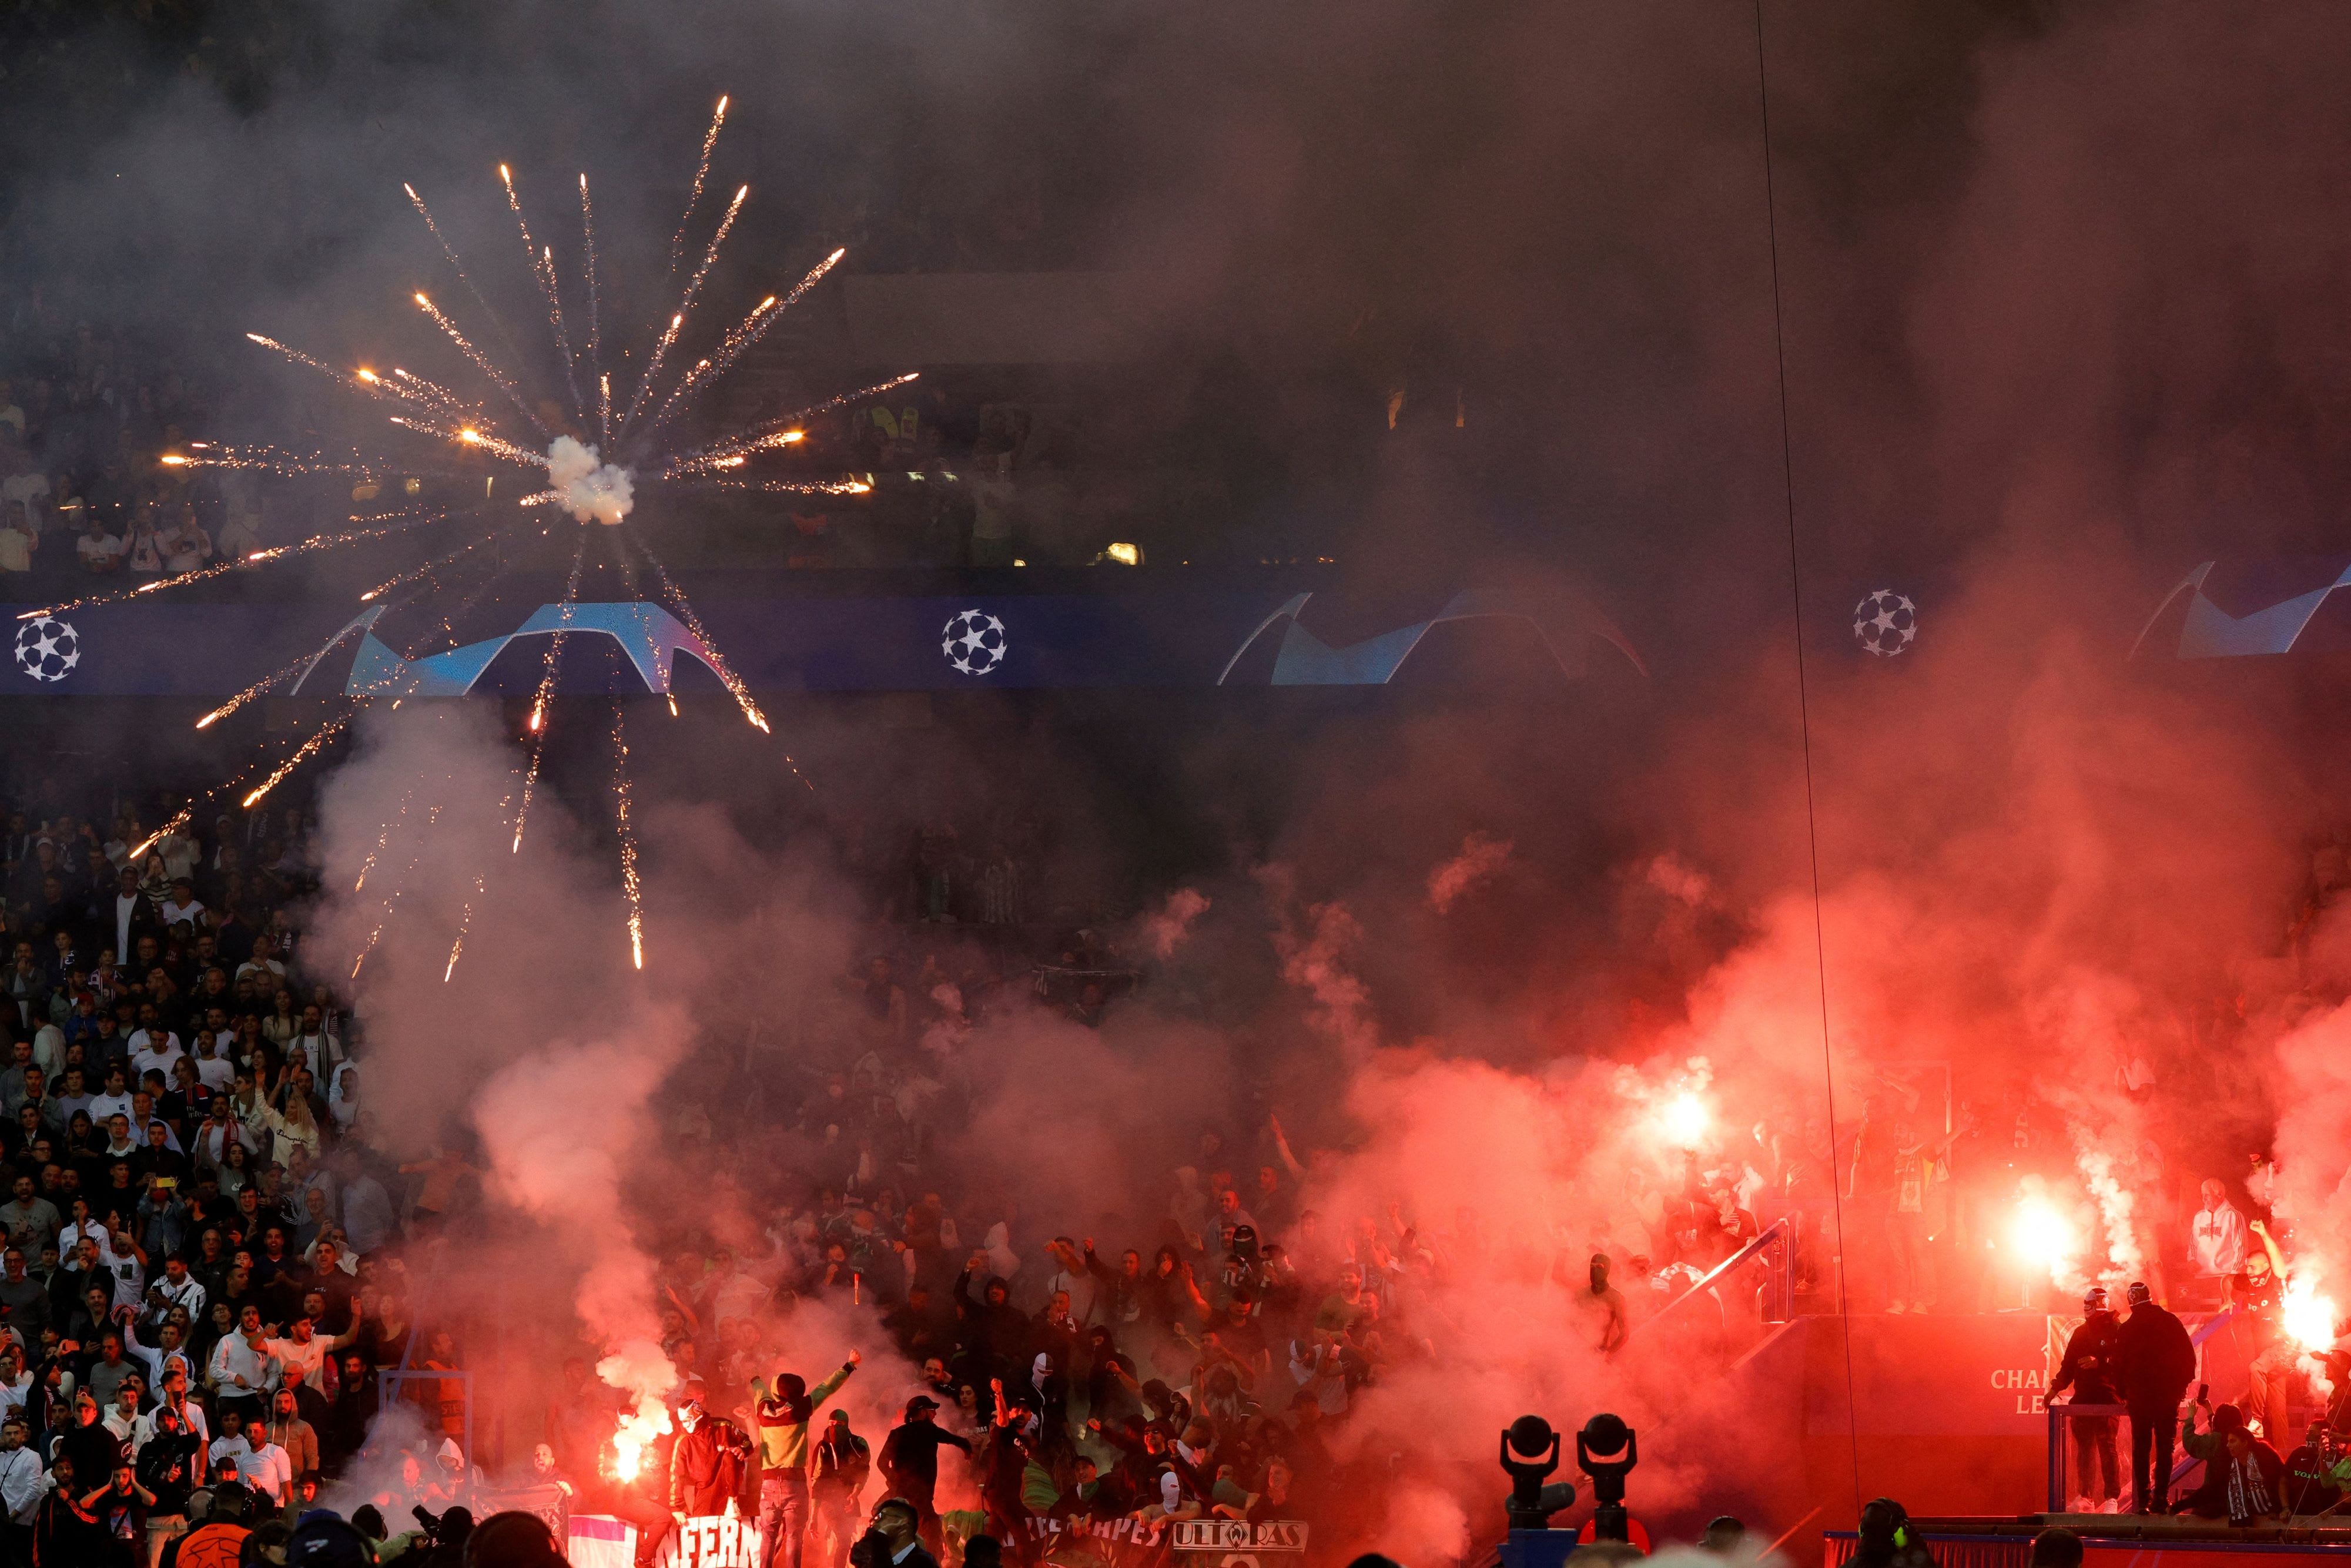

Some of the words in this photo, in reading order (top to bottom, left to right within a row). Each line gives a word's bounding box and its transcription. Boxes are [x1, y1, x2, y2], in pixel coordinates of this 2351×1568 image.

[1991, 1369, 2048, 1389] CHA
[2017, 1395, 2049, 1414] LE
[2295, 1470, 2320, 1479] VOLV
[654, 1516, 762, 1568] NFERN
